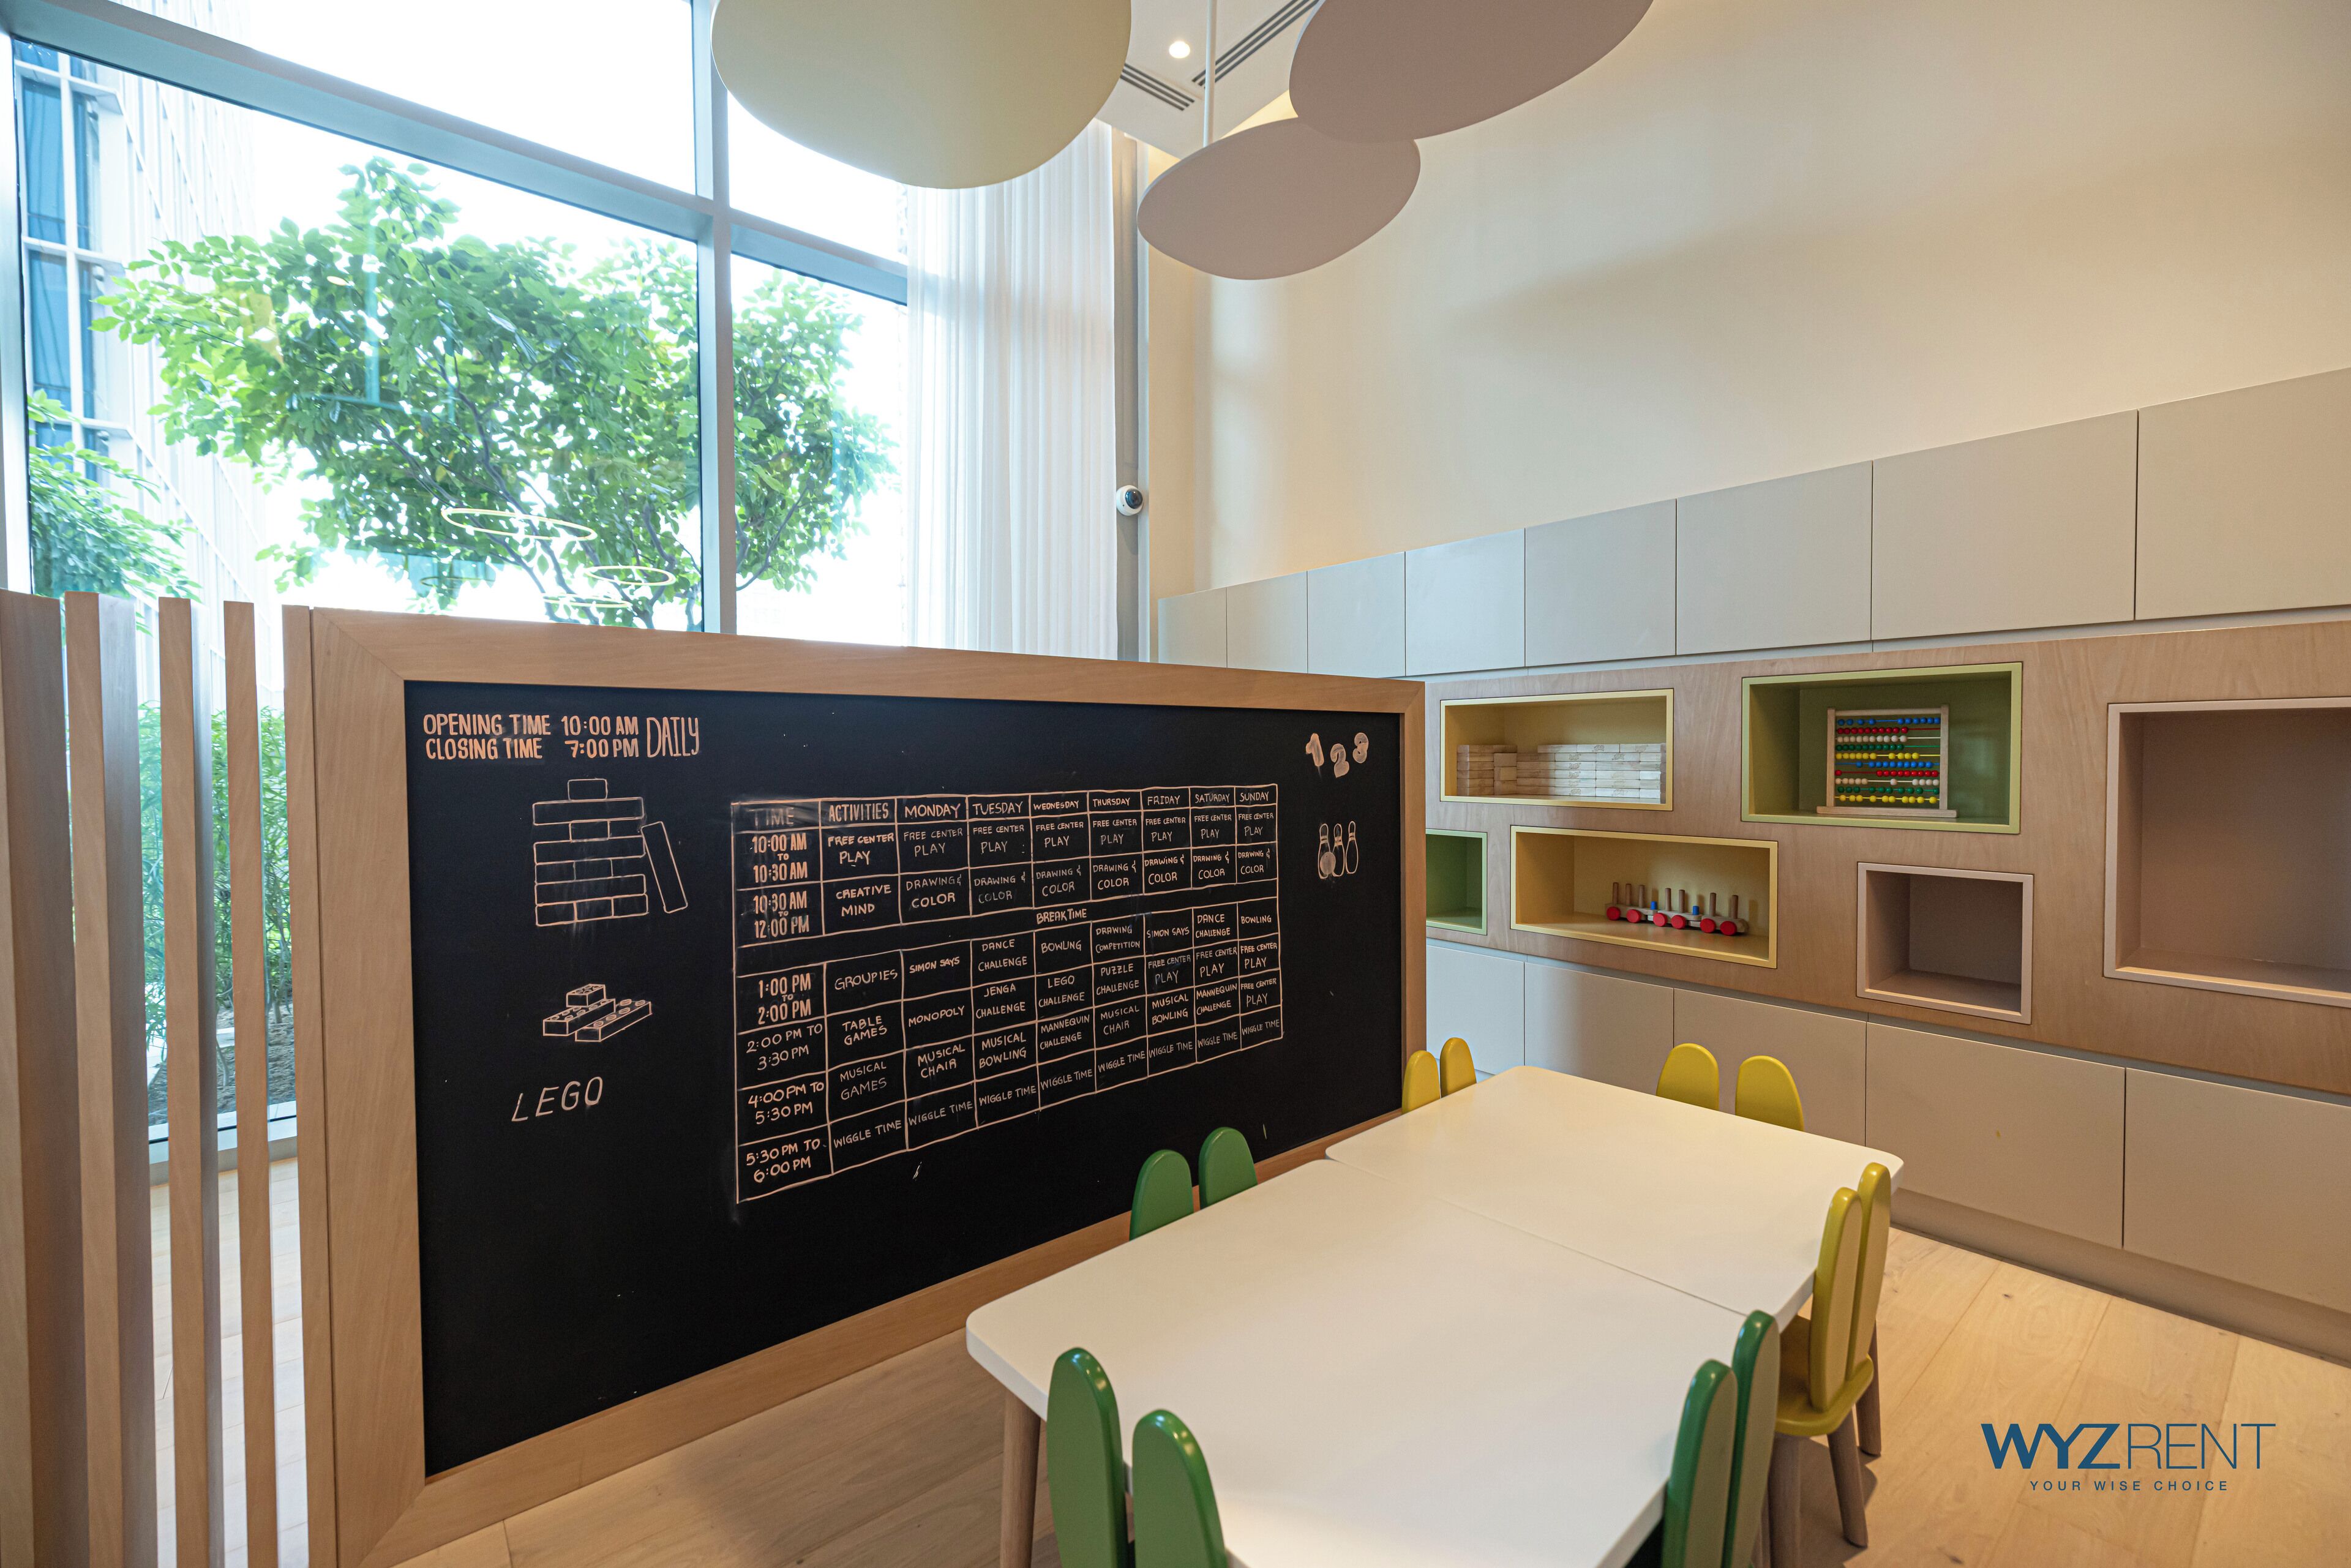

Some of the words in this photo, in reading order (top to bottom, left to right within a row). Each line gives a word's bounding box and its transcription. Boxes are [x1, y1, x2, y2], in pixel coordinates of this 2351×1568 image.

[424, 713, 502, 735] OPENING
[509, 715, 551, 735] TIME
[561, 716, 610, 736] 10:00
[617, 716, 639, 735] AM
[647, 717, 699, 757] DAILY
[426, 738, 498, 760] CLOSING
[503, 738, 542, 759] TIME
[564, 739, 609, 758] 7:00
[613, 738, 639, 757] PM
[1093, 798, 1130, 807] THURSDAY
[1148, 795, 1180, 805] FRIDAY
[1195, 793, 1229, 803] SATURDAY
[1240, 792, 1269, 801] SUNDAY
[829, 803, 888, 822] ACTIVITIES
[905, 803, 960, 818] MONDAY
[972, 801, 1022, 815] TUESDAY
[1033, 800, 1079, 810] WEDNESDAY
[748, 808, 793, 826] TIME
[904, 831, 926, 841] FREE
[931, 828, 962, 838] CENTER
[973, 826, 992, 835] FREE
[1151, 831, 1172, 842] PLAY
[1201, 829, 1219, 839] PLAY
[1244, 826, 1262, 836] PLAY
[752, 835, 787, 853] 10:00
[791, 833, 807, 850] AM
[828, 836, 855, 847] FREE
[857, 833, 894, 844] CENTER
[981, 841, 1007, 853] PLAY
[1044, 836, 1069, 847] PLAY
[1101, 834, 1123, 845] PLAY
[915, 842, 945, 857] PLAY
[839, 850, 870, 865] PLAY
[753, 863, 787, 883] 10:30
[790, 861, 808, 879] AM
[1036, 868, 1073, 879] DRAWING
[1093, 863, 1128, 872] DRAWING
[1199, 868, 1224, 879] COLOR
[1240, 865, 1264, 874] COLOR
[906, 876, 954, 891] DRAWING
[974, 876, 1016, 886] DRAWING
[1098, 877, 1129, 890] COLOR
[1149, 872, 1177, 885] COLOR
[836, 885, 891, 899] CREATIVE
[1042, 882, 1074, 896] COLOR
[753, 893, 786, 914] 10:30
[790, 891, 807, 909] AM
[912, 892, 955, 908] COLOR
[842, 903, 875, 917] MIND
[754, 918, 787, 938] 12:00
[791, 915, 809, 934] PM
[1198, 914, 1224, 924] DANCE
[1241, 915, 1272, 924] BOWLING
[1096, 925, 1132, 935] DRAWING
[1147, 929, 1169, 938] SIMON
[1172, 927, 1190, 936] SAYS
[1196, 928, 1230, 938] CHALLENGE
[981, 939, 1015, 951] DANCE
[1041, 940, 1081, 953] BOWLING
[1096, 941, 1140, 953] COMPETITION
[1240, 945, 1254, 954] FREE
[1257, 942, 1277, 951] CENTER
[1196, 950, 1212, 959] FREE
[1215, 948, 1237, 957] CENTER
[910, 961, 937, 973] SIMON
[940, 956, 960, 967] SAYS
[978, 956, 1027, 972] CHALLENGE
[1101, 963, 1133, 976] PUZZLE
[1148, 959, 1165, 969] FREE
[1167, 955, 1191, 964] CENTER
[1245, 957, 1266, 969] PLAY
[1155, 970, 1178, 985] PLAY
[1200, 963, 1224, 978] PLAY
[759, 977, 787, 999] 1:00
[792, 973, 811, 992] PM
[834, 969, 898, 990] GROUPIES
[1048, 975, 1074, 988] LEGO
[1256, 978, 1277, 988] CENTER
[984, 983, 1016, 997] JENGA
[1097, 980, 1139, 995] CHALLENGE
[1196, 983, 1237, 999] MANNEQUIN
[1038, 992, 1084, 1007] CHALLENGE
[1152, 994, 1188, 1009] MUSICAL
[1247, 993, 1267, 1007] PLAY
[758, 1003, 787, 1024] 2:00
[792, 999, 811, 1018] PM
[976, 1002, 1026, 1019] CHALLENGE
[1101, 1005, 1139, 1020] MUSICAL
[1196, 1000, 1231, 1015] CHALLENGE
[842, 1016, 882, 1031] TABLE
[909, 1005, 964, 1027] MONOPOLY
[1152, 1008, 1188, 1025] BOWLING
[1041, 1015, 1089, 1033] MANNEQUIN
[1103, 1020, 1129, 1035] CHAIR
[746, 1034, 782, 1053] 2:00
[786, 1029, 801, 1041] PM
[806, 1024, 822, 1036] TO
[844, 1025, 887, 1045] GAMES
[982, 1032, 1026, 1050] MUSICAL
[1040, 1032, 1082, 1049] CHALLENGE
[757, 1050, 789, 1070] 3:30
[792, 1045, 809, 1059] PM
[918, 1044, 965, 1067] MUSICAL
[980, 1047, 1026, 1068] BOWLING
[840, 1062, 887, 1082] MUSICAL
[921, 1059, 956, 1078] CHAIR
[1040, 1075, 1073, 1090] WIGGLE
[1074, 1069, 1092, 1080] TIME
[748, 1089, 784, 1108] 4:00
[786, 1084, 806, 1099] PM
[810, 1082, 824, 1092] TO
[841, 1078, 887, 1100] GAMES
[979, 1091, 1012, 1106] WIGGLE
[1015, 1086, 1036, 1097] TIME
[511, 1076, 602, 1122] LEGO
[756, 1106, 791, 1125] 5:30
[794, 1101, 812, 1115] PM
[909, 1108, 946, 1125] WIGGLE
[950, 1101, 973, 1116] TIME
[834, 1130, 871, 1148] WIGGLE
[875, 1120, 901, 1135] TIME
[746, 1148, 779, 1166] 5:30
[782, 1143, 798, 1155] PM
[803, 1138, 820, 1151] TO
[754, 1161, 790, 1183] 6:00
[793, 1156, 811, 1171] PM
